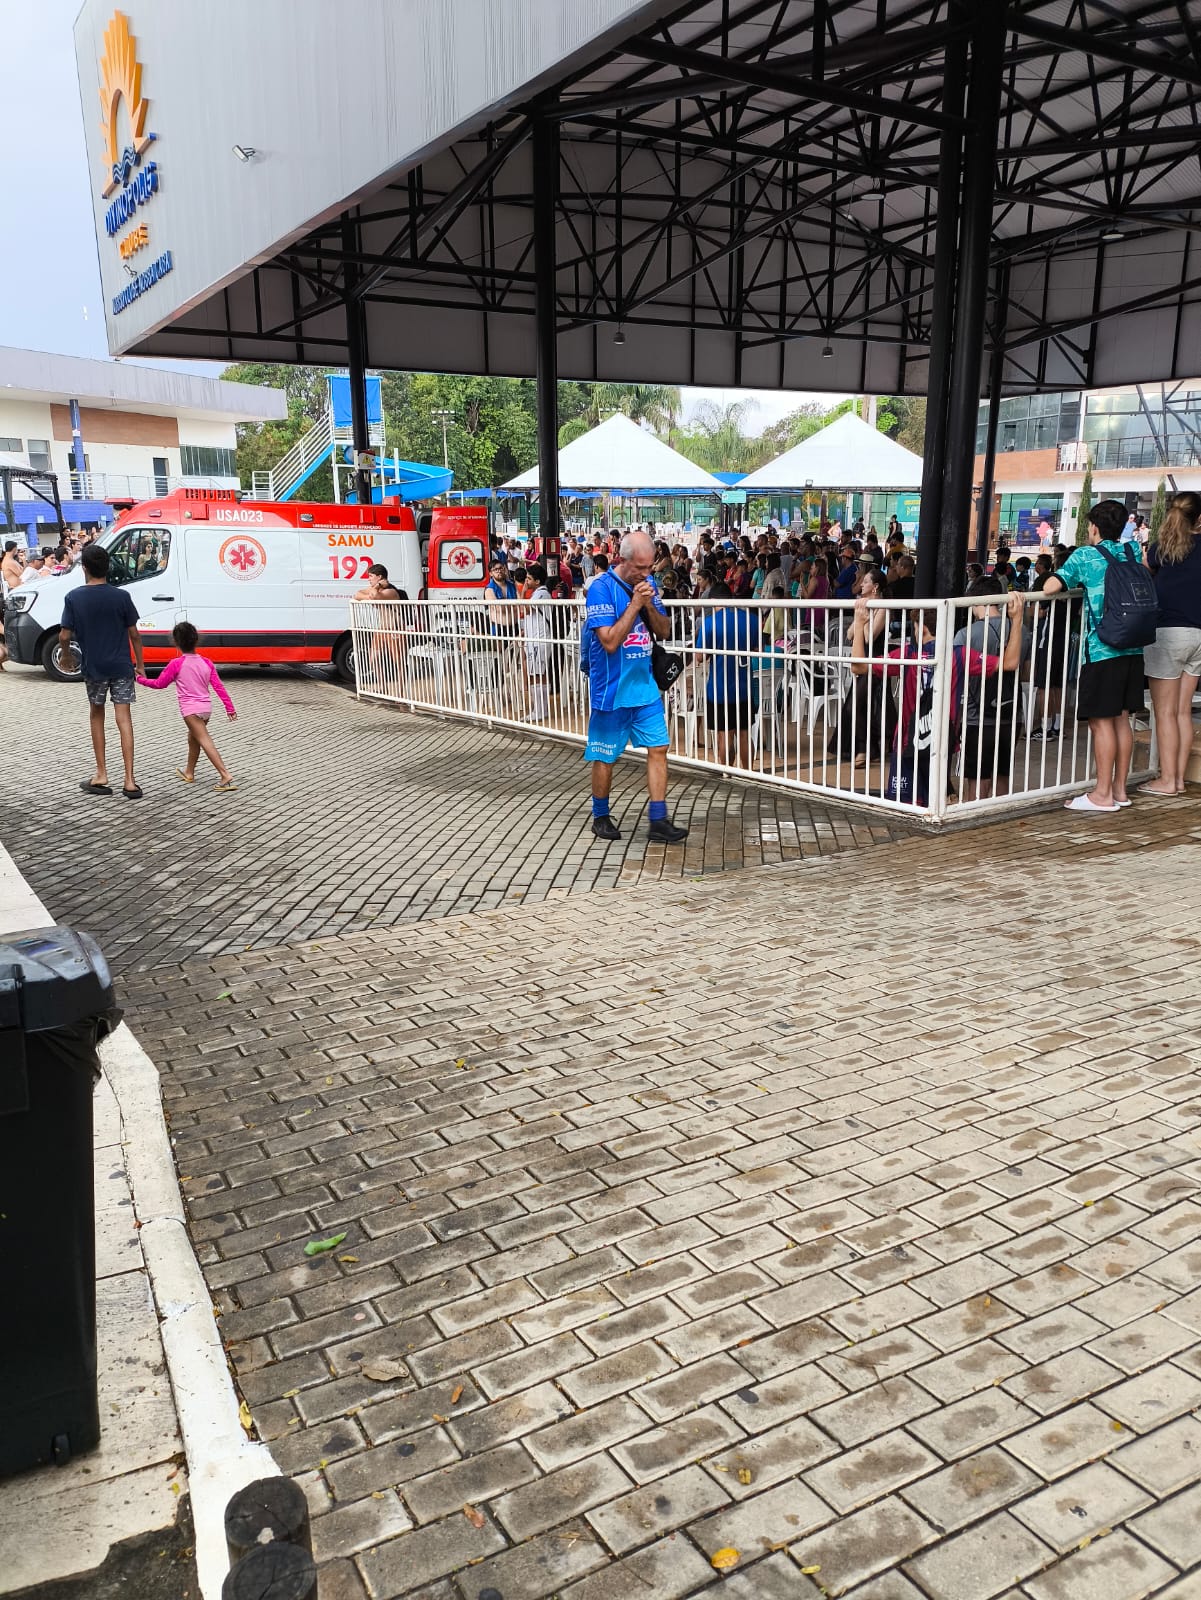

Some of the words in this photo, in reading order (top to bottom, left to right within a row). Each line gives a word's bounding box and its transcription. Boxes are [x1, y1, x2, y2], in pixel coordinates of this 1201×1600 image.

[119, 222, 149, 260] CLUBE
[216, 509, 264, 523] USA023
[328, 534, 374, 547] SAMU
[328, 555, 374, 580] 192
